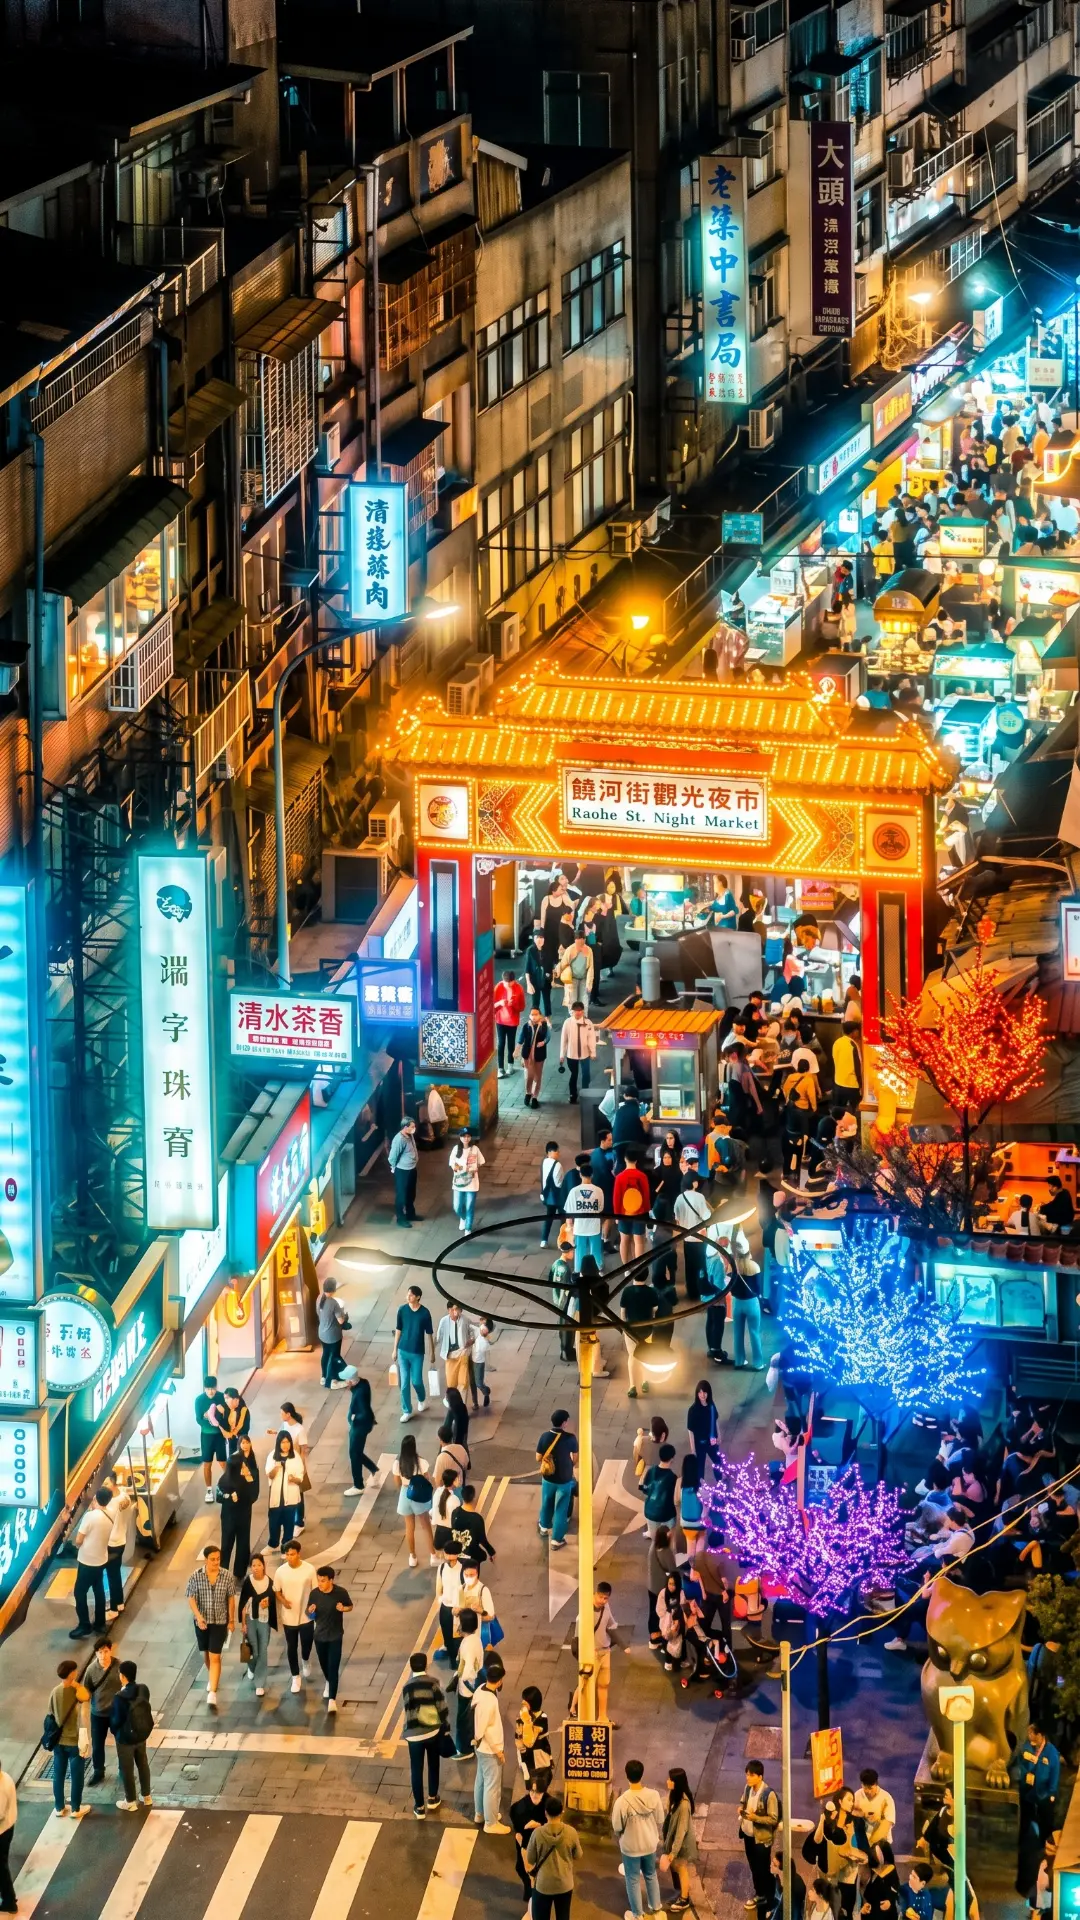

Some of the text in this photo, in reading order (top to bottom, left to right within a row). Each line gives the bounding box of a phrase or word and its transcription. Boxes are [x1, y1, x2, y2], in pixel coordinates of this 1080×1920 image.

[571, 777, 760, 812] 饒河街觀光夜市
[571, 807, 760, 830] Raohe St. Night Market
[237, 1001, 343, 1037] 清水茶香
